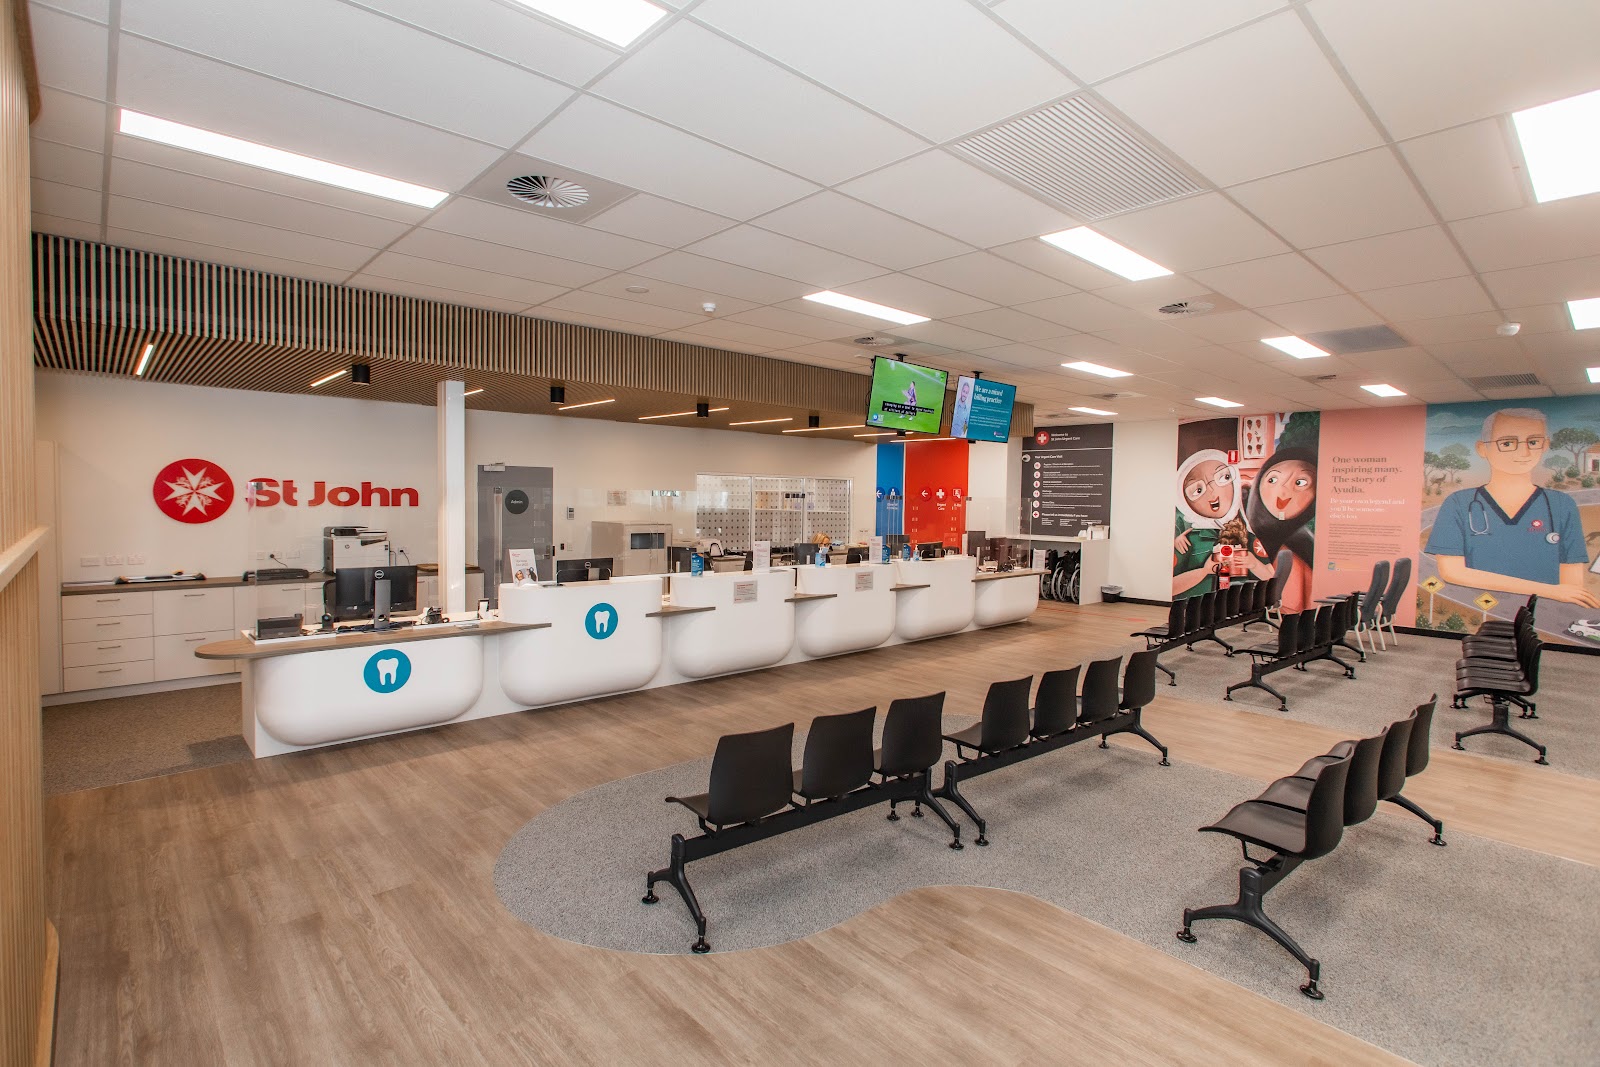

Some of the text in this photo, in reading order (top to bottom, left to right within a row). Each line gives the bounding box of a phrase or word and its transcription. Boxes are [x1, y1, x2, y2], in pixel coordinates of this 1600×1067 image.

[1332, 466, 1372, 474] inspiring
[245, 478, 419, 507] St John
